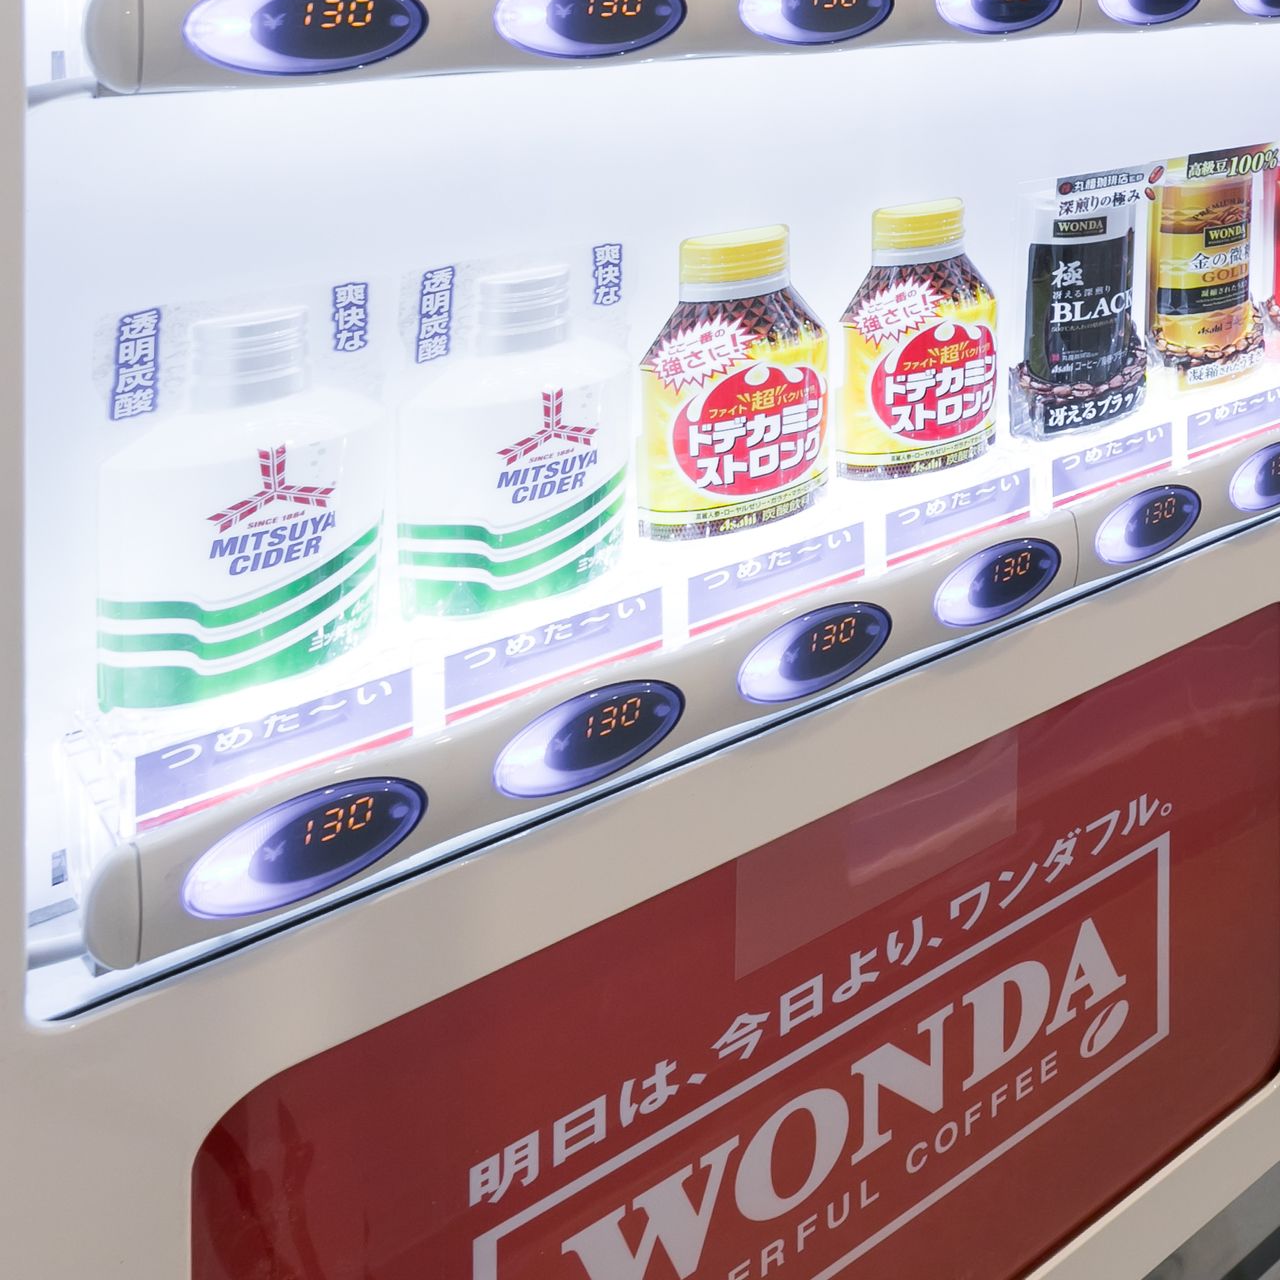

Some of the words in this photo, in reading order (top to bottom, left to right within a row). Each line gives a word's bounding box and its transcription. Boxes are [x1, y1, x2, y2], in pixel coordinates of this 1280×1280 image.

[1058, 189, 1140, 216] 深煎りの極み
[1058, 219, 1103, 233] WONDA
[595, 244, 622, 305] 爽快な
[1051, 260, 1084, 288] 極
[334, 284, 367, 351] 爽快な
[417, 269, 453, 362] 透明炭酸
[863, 292, 930, 335] 強さに!
[868, 290, 917, 313] ここ一番の
[661, 333, 740, 379] 強さに!
[667, 330, 727, 355] ここ一番の
[113, 312, 157, 419] 透明炭酸
[885, 355, 996, 405] ドデカミン
[688, 398, 823, 457] ドデカミン
[709, 405, 746, 419] ファイト
[892, 388, 994, 434] ストロング
[497, 449, 598, 489] MITSUYA
[528, 454, 553, 464] SINCE
[696, 426, 820, 489] ストロング
[911, 457, 942, 473] Asahi
[511, 471, 586, 505] CIDER
[209, 510, 337, 560] MITSUYA
[247, 518, 279, 530] SINCE
[720, 514, 756, 532] Asahi
[228, 537, 322, 576] CIDER
[812, 618, 857, 651] 130
[587, 698, 641, 738] 130
[306, 797, 375, 846] 130
[468, 792, 1175, 1208] 明日は、今日より、ワンダフル。
[561, 918, 1127, 1280] WONDA
[906, 1051, 1062, 1176] COFFEE
